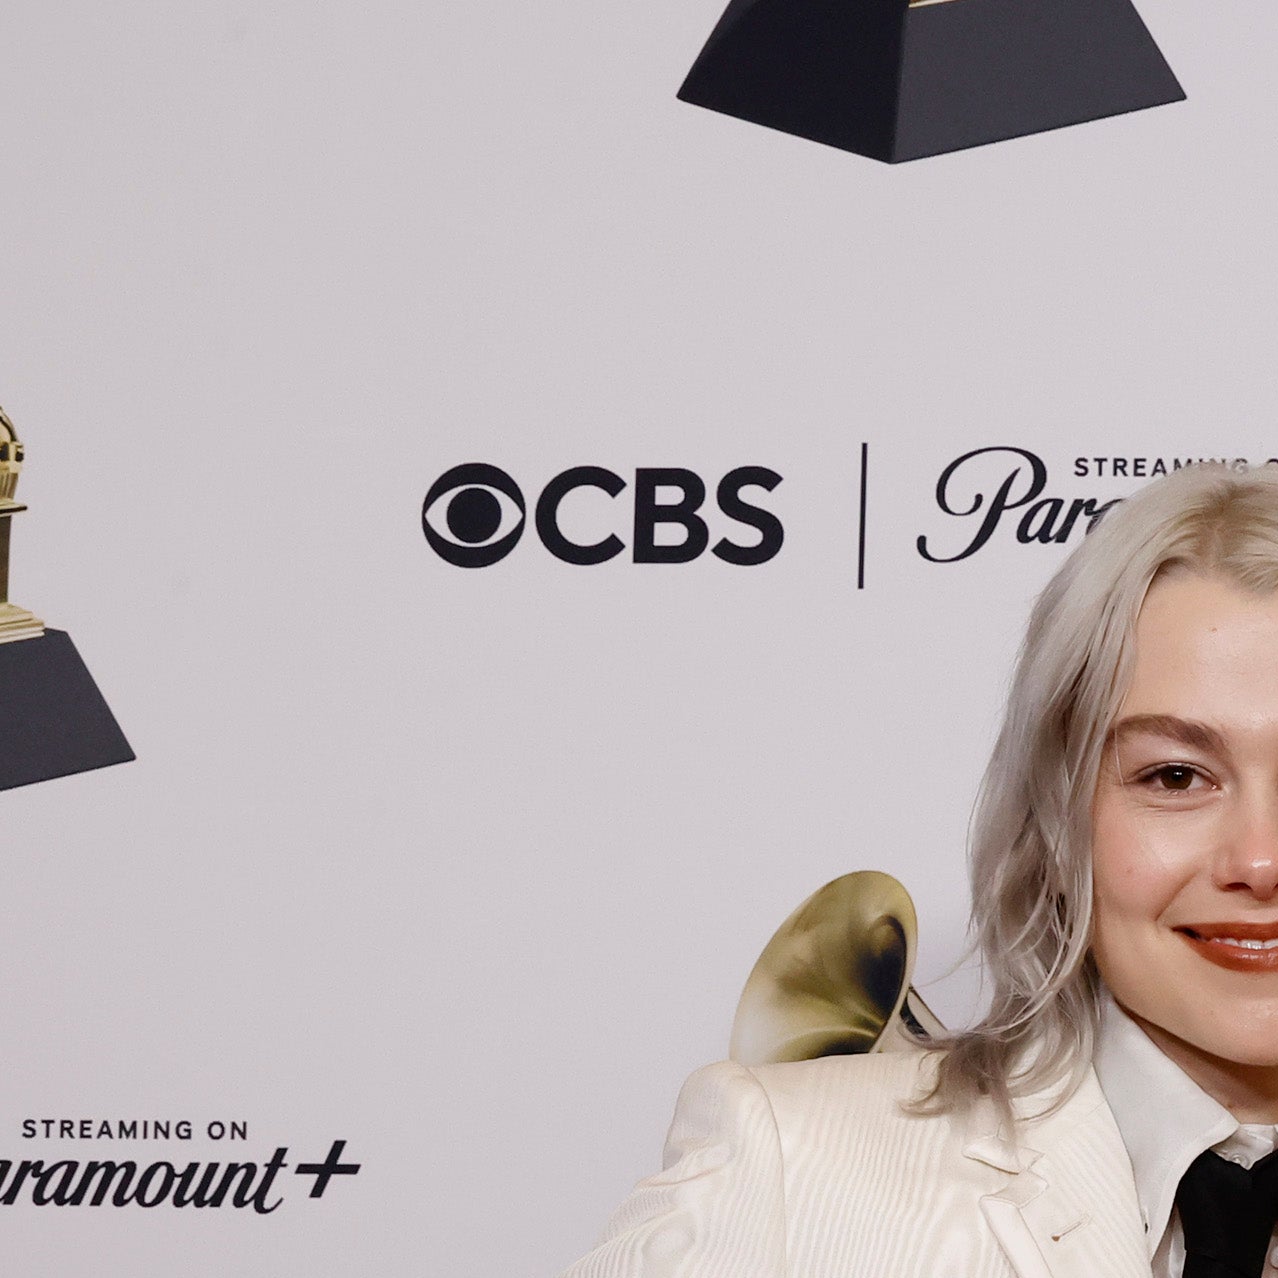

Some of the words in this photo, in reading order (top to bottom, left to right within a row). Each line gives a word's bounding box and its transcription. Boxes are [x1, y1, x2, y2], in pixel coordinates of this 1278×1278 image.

[535, 465, 784, 567] CBS
[22, 1119, 192, 1140] STREAMING
[208, 1120, 247, 1141] ON
